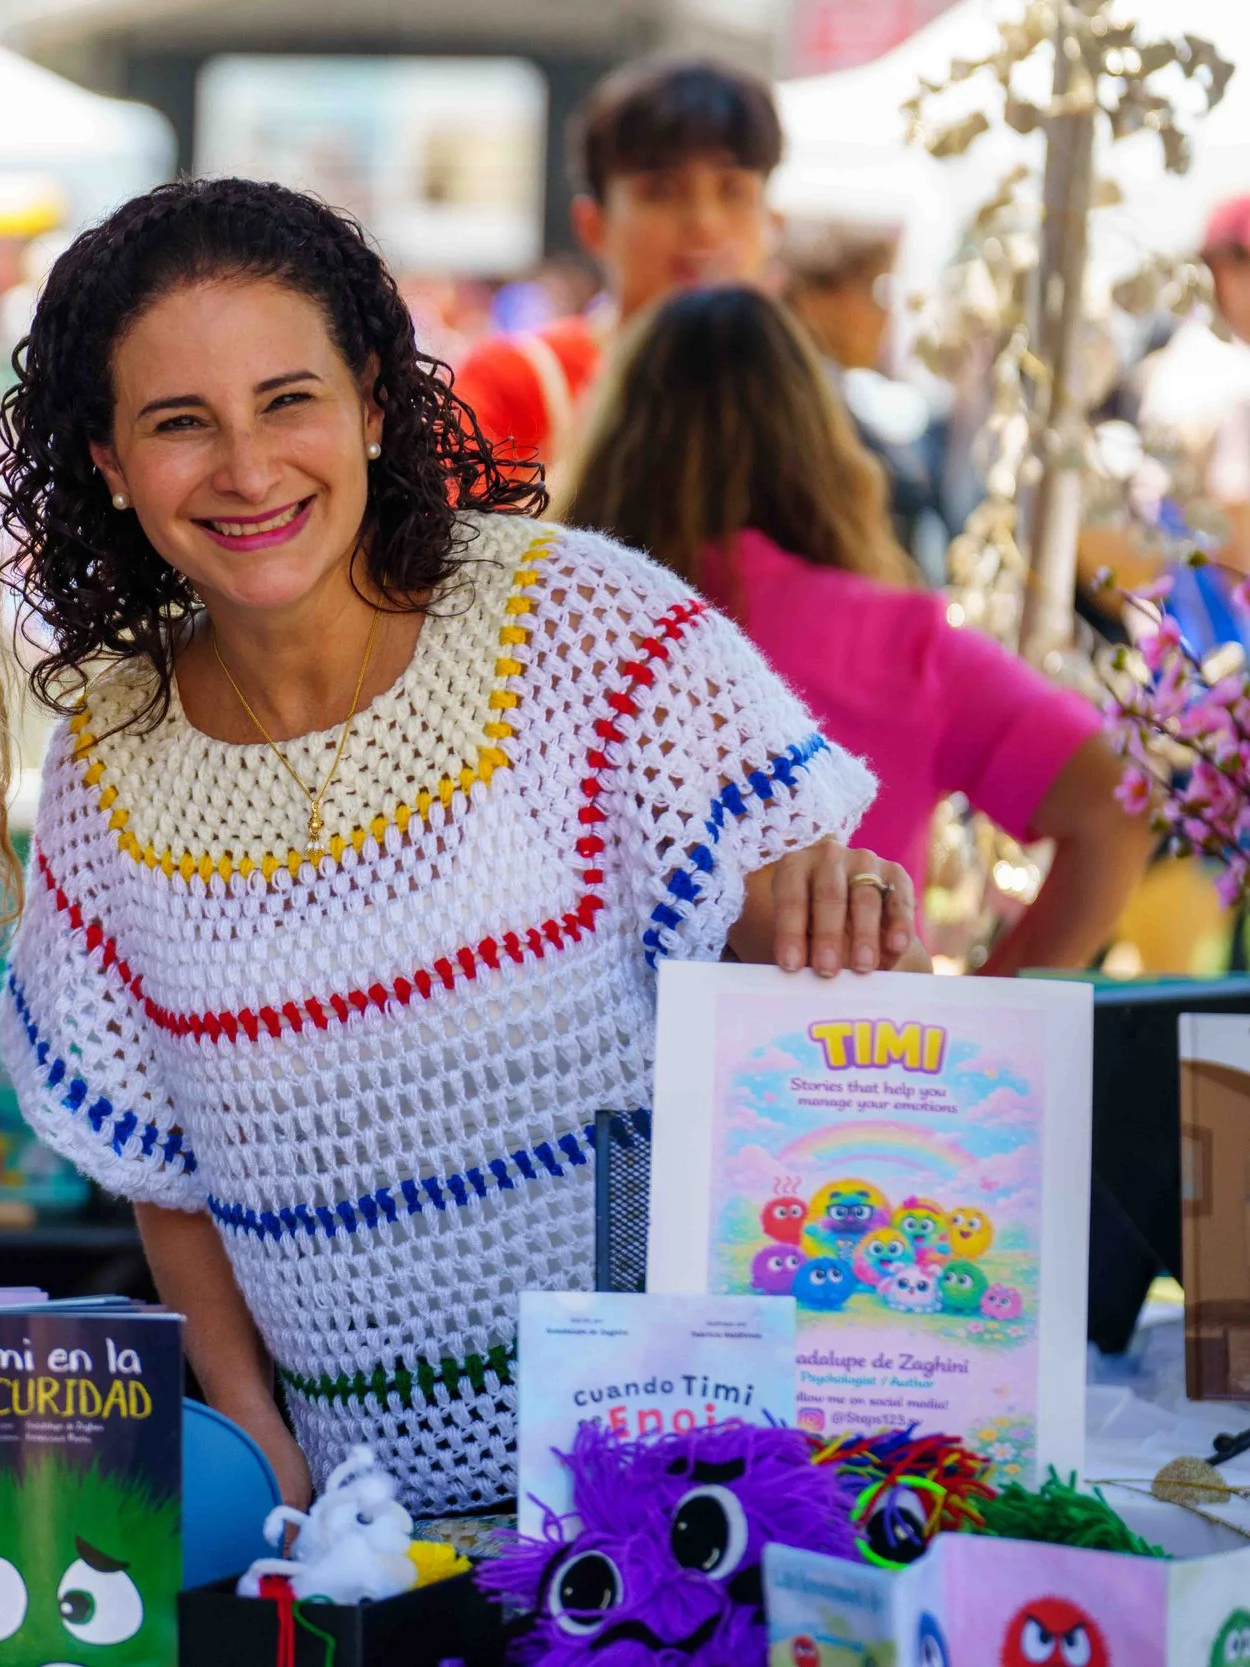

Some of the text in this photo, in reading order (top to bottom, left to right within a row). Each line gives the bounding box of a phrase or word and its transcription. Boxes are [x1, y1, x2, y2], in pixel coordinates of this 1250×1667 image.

[808, 1018, 946, 1075] TIMI
[790, 1077, 947, 1101] Stories that help you
[798, 1096, 958, 1115] manage your emotions
[47, 1348, 93, 1373] en
[105, 1337, 142, 1375] la
[871, 1353, 894, 1370] de
[898, 1353, 970, 1379] Zaghini
[681, 1374, 755, 1406] Timi
[800, 1371, 876, 1388] Psychologist
[890, 1374, 934, 1388] Author
[869, 1396, 903, 1408] social
